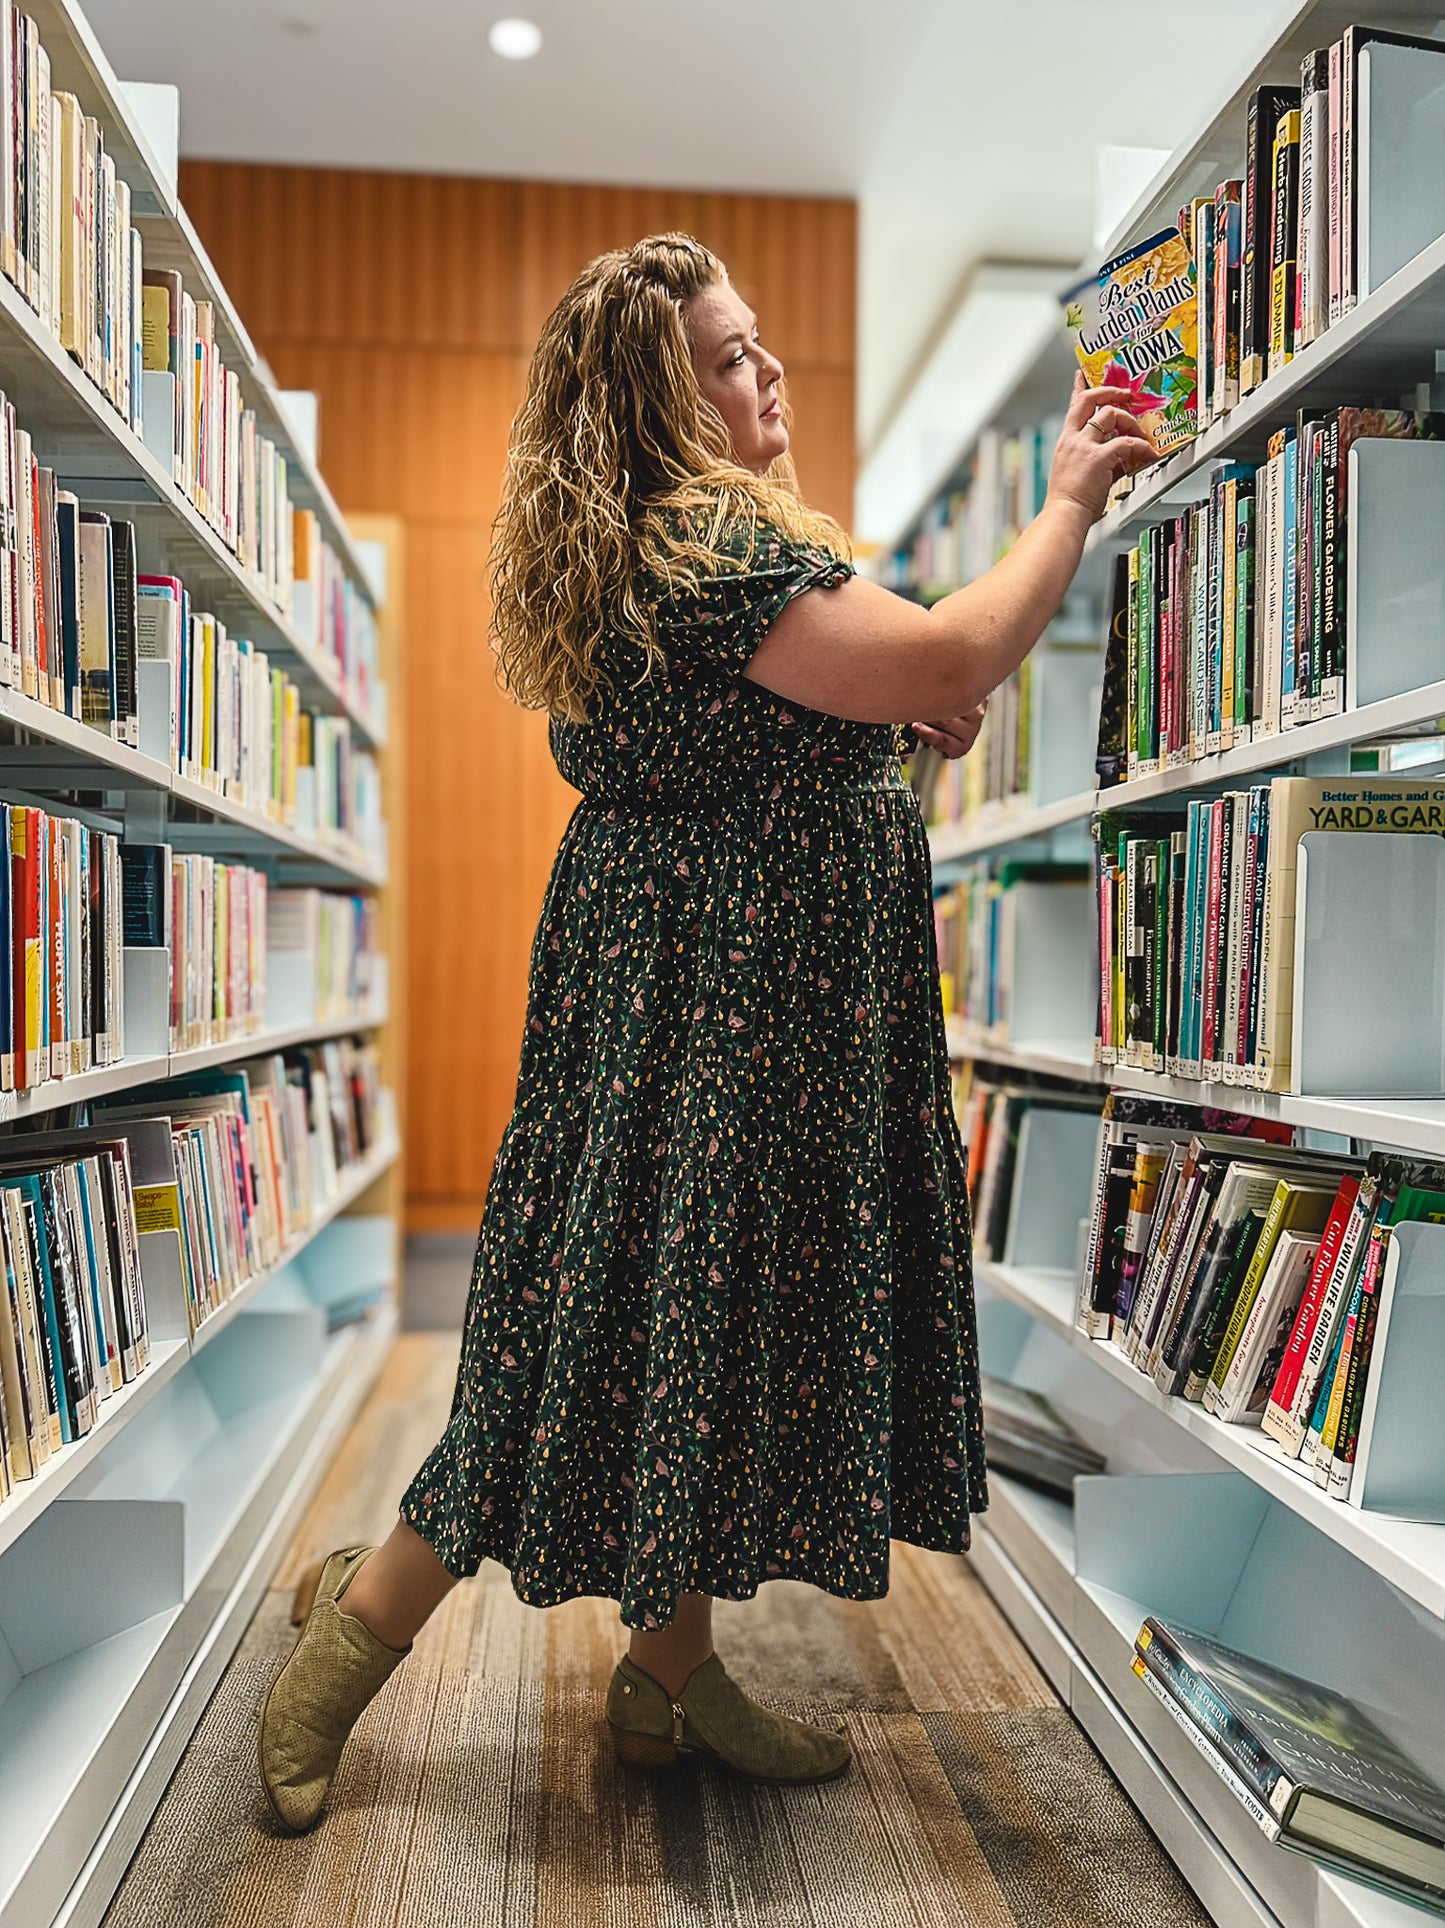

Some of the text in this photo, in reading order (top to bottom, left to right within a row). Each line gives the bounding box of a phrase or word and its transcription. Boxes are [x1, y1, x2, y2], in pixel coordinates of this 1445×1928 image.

[1301, 105, 1312, 218] TRUFFLE HOUND
[1274, 151, 1286, 263] Herb Gardening
[1079, 306, 1140, 356] Garden
[1136, 276, 1195, 321] Plants
[1099, 268, 1155, 313] Best
[1135, 324, 1154, 341] for
[1271, 280, 1283, 354] DUMMIES
[1119, 328, 1184, 379] IOWA
[1152, 413, 1185, 438] Chuck
[1157, 428, 1187, 449] Laura
[1329, 421, 1337, 468] MASTERING
[1269, 486, 1277, 526] Flower
[1268, 528, 1277, 589] Gardener's
[1323, 475, 1334, 633] FLOWER GARDENING
[1138, 565, 1148, 667] year in the garden
[1267, 591, 1276, 622] Bible
[1284, 526, 1297, 667] GARDENTOPIA
[1195, 583, 1206, 707] WATER GARDENS
[1309, 805, 1445, 829] YARD & GAR
[1322, 791, 1359, 802] Better
[1362, 790, 1403, 802] Homes
[1406, 790, 1429, 802] and
[1220, 822, 1230, 876] ORGANIC
[1219, 878, 1227, 912] LAWN
[1232, 864, 1240, 918] GARDENING
[1254, 861, 1264, 903] SHADE
[54, 921, 63, 976] PEOPLE
[1192, 915, 1202, 974] GARDEN
[1207, 920, 1217, 958] Flower
[1217, 915, 1225, 946] CARE
[1236, 838, 1256, 1054] container gardening PAUL WILLIAMS
[1145, 929, 1153, 1008] FLORIOGRAPHY
[1203, 959, 1214, 1020] gardening
[1261, 965, 1269, 1004] owners
[1260, 1007, 1268, 1045] manual
[1097, 1122, 1110, 1193] Essential
[1086, 1192, 1102, 1273] Perennials
[1266, 1197, 1283, 1227] HILTON
[1324, 1219, 1343, 1247] Cut
[1347, 1212, 1358, 1235] CREATE
[1250, 1261, 1260, 1274] THE
[1255, 1225, 1273, 1259] CARTER
[21, 1270, 31, 1311] MIND
[1151, 1256, 1165, 1288] NATIVE
[1163, 1252, 1188, 1316] SUCCULENTS
[1305, 1248, 1334, 1302] Flower
[1345, 1271, 1367, 1318] BALCONY
[1140, 1287, 1156, 1320] PLANTS
[1225, 1272, 1258, 1338] PROPAGATION
[1288, 1300, 1317, 1355] Garden
[1306, 1241, 1354, 1365] WILDLIFE GARDEN
[1209, 1335, 1236, 1385] HANDBOOK
[1230, 1294, 1268, 1379] houseplants for all
[1315, 1355, 1339, 1415] Alex Mitchell
[1335, 1295, 1371, 1448] CONTAINER FRAGRANT GARDENS
[1339, 1350, 1351, 1375] How
[1327, 1388, 1343, 1429] Window
[1176, 1666, 1231, 1729] ENCYCLOPEDIA
[1198, 1714, 1225, 1745] Plants
[1273, 1738, 1381, 1794] Garden
